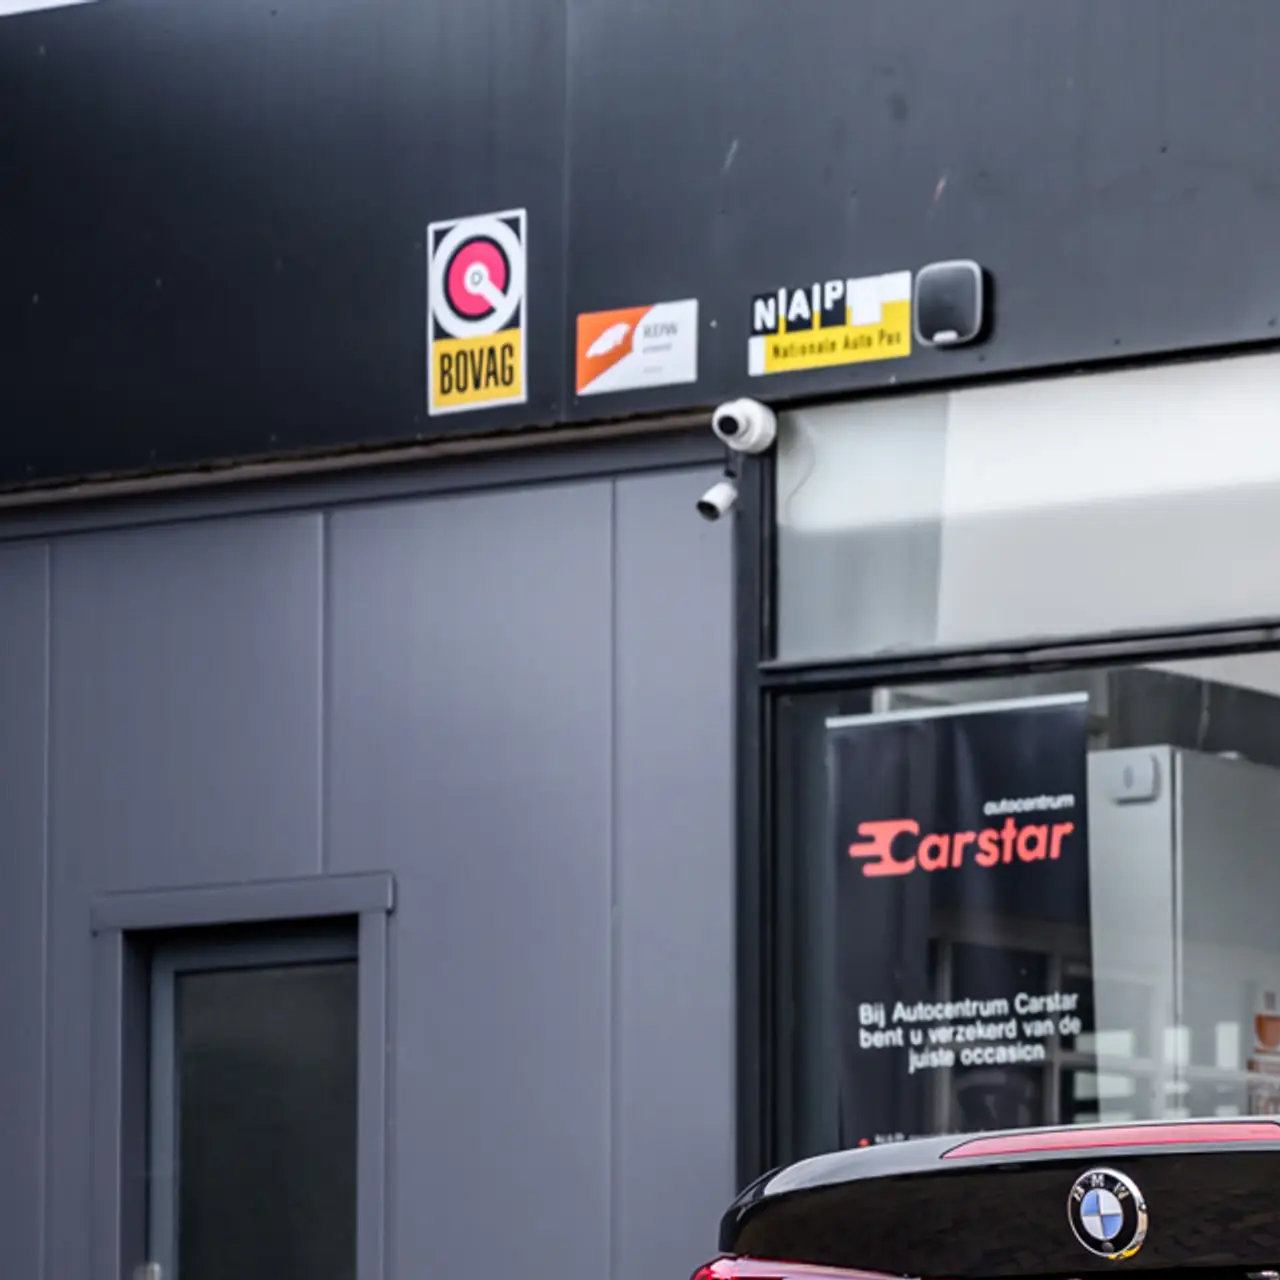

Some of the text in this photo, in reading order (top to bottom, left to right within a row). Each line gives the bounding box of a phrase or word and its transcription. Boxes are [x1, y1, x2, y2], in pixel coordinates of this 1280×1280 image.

[772, 338, 837, 359] Nationale
[844, 332, 873, 350] Auto
[440, 342, 514, 396] BOVAG
[983, 794, 1075, 816] autocentrum
[849, 817, 1075, 877] Carstar
[858, 992, 1079, 1028] Bij Autocentrum Carstar
[859, 1015, 1082, 1049] bent u verzekerd van de
[908, 1046, 955, 1075] juiste
[1071, 1173, 1131, 1203] BMW
